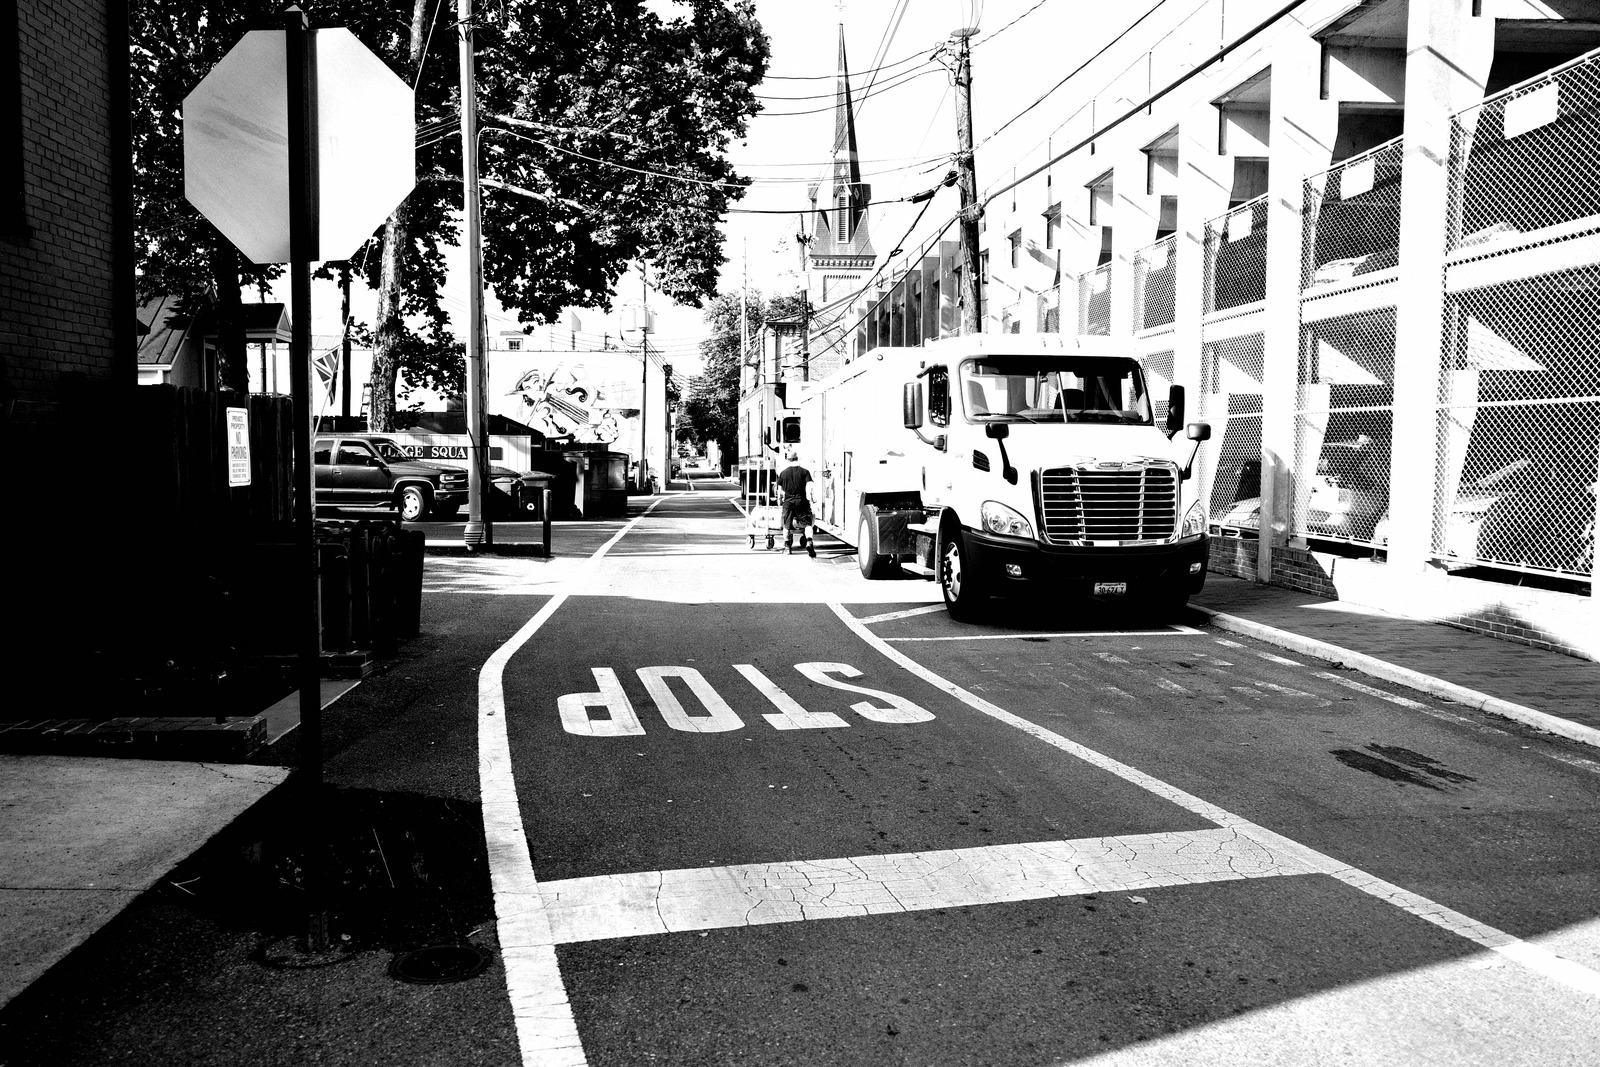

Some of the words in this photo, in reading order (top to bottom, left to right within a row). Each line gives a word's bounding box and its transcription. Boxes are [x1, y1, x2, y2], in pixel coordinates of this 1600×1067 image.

[230, 422, 246, 430] PROPERTY
[235, 431, 242, 445] NO
[231, 446, 247, 460] PARKING
[431, 446, 467, 458] SQUA
[556, 661, 937, 737] STOP
